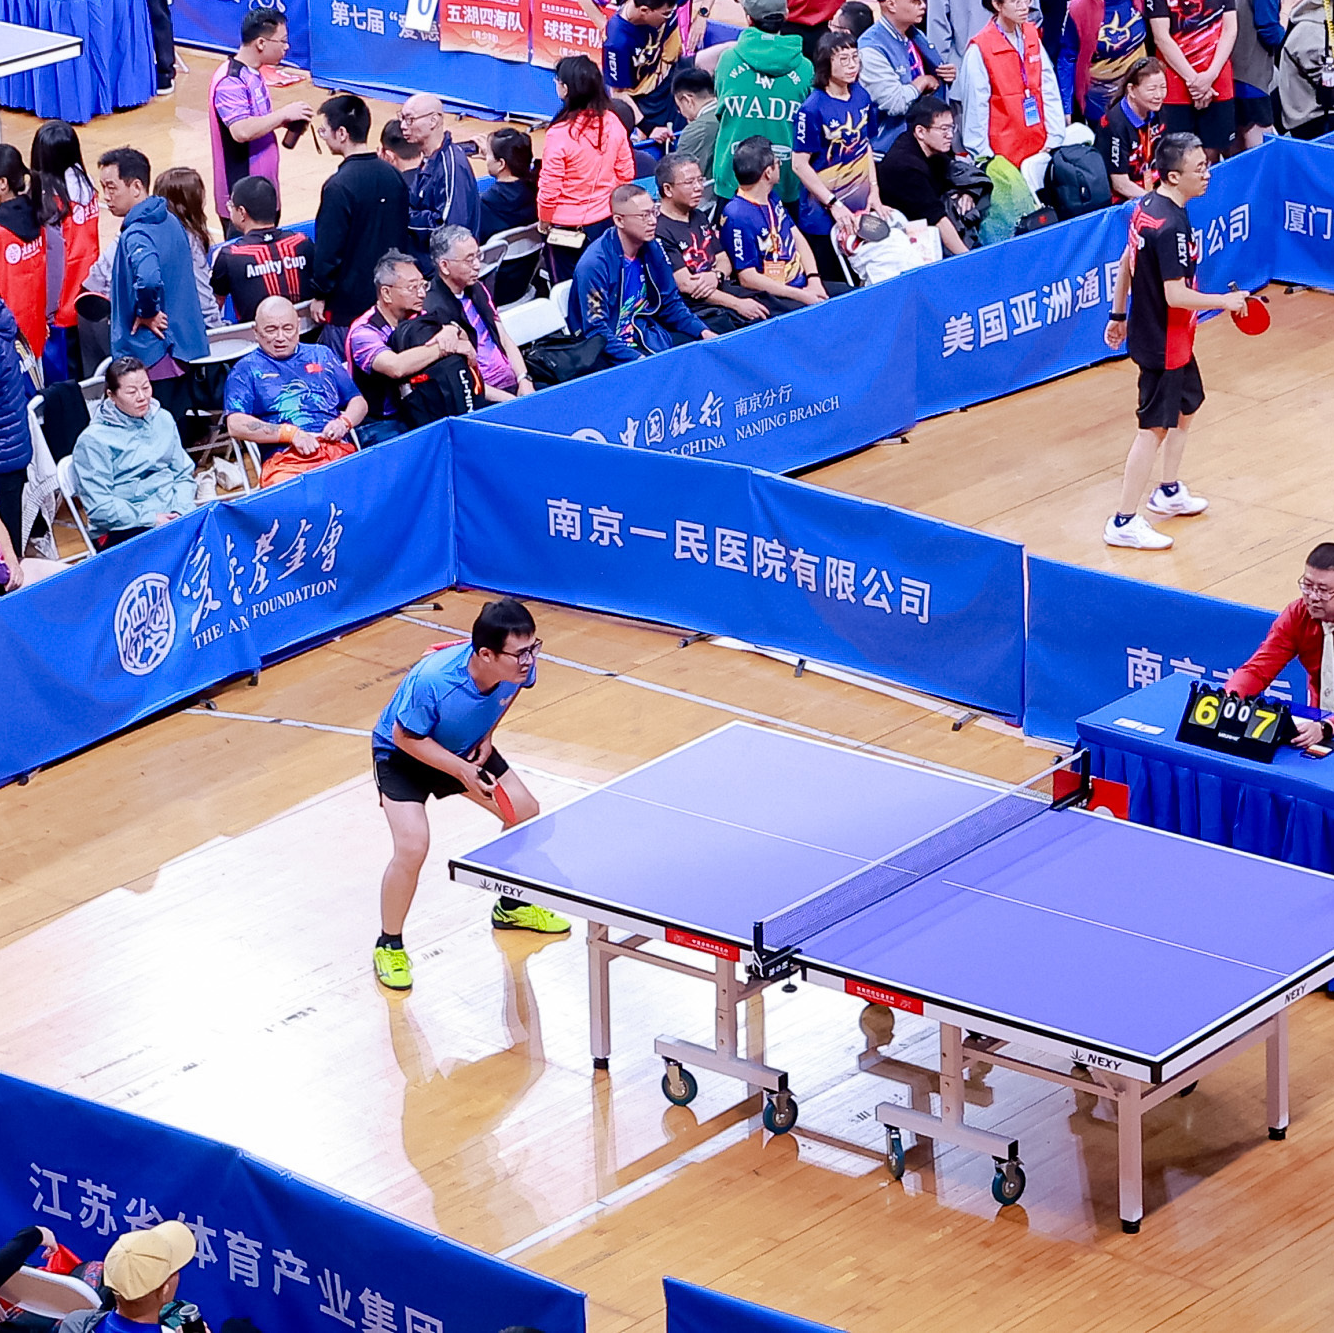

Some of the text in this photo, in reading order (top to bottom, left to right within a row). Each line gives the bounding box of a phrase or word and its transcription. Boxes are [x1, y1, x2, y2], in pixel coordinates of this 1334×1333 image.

[447, 4, 524, 32] 五湖四海队
[246, 255, 307, 278] Amity Cup
[735, 384, 792, 416] 南京分行
[736, 411, 786, 442] NANJING
[789, 396, 840, 424] BRANCH
[548, 498, 931, 624] 南京一民医院有限公司
[193, 578, 338, 650] THE FOUNDATION
[1193, 695, 1278, 740] 6 00 7
[494, 881, 524, 899] NEXY
[1283, 983, 1307, 1005] NEXY
[1087, 1052, 1122, 1071] NEXY
